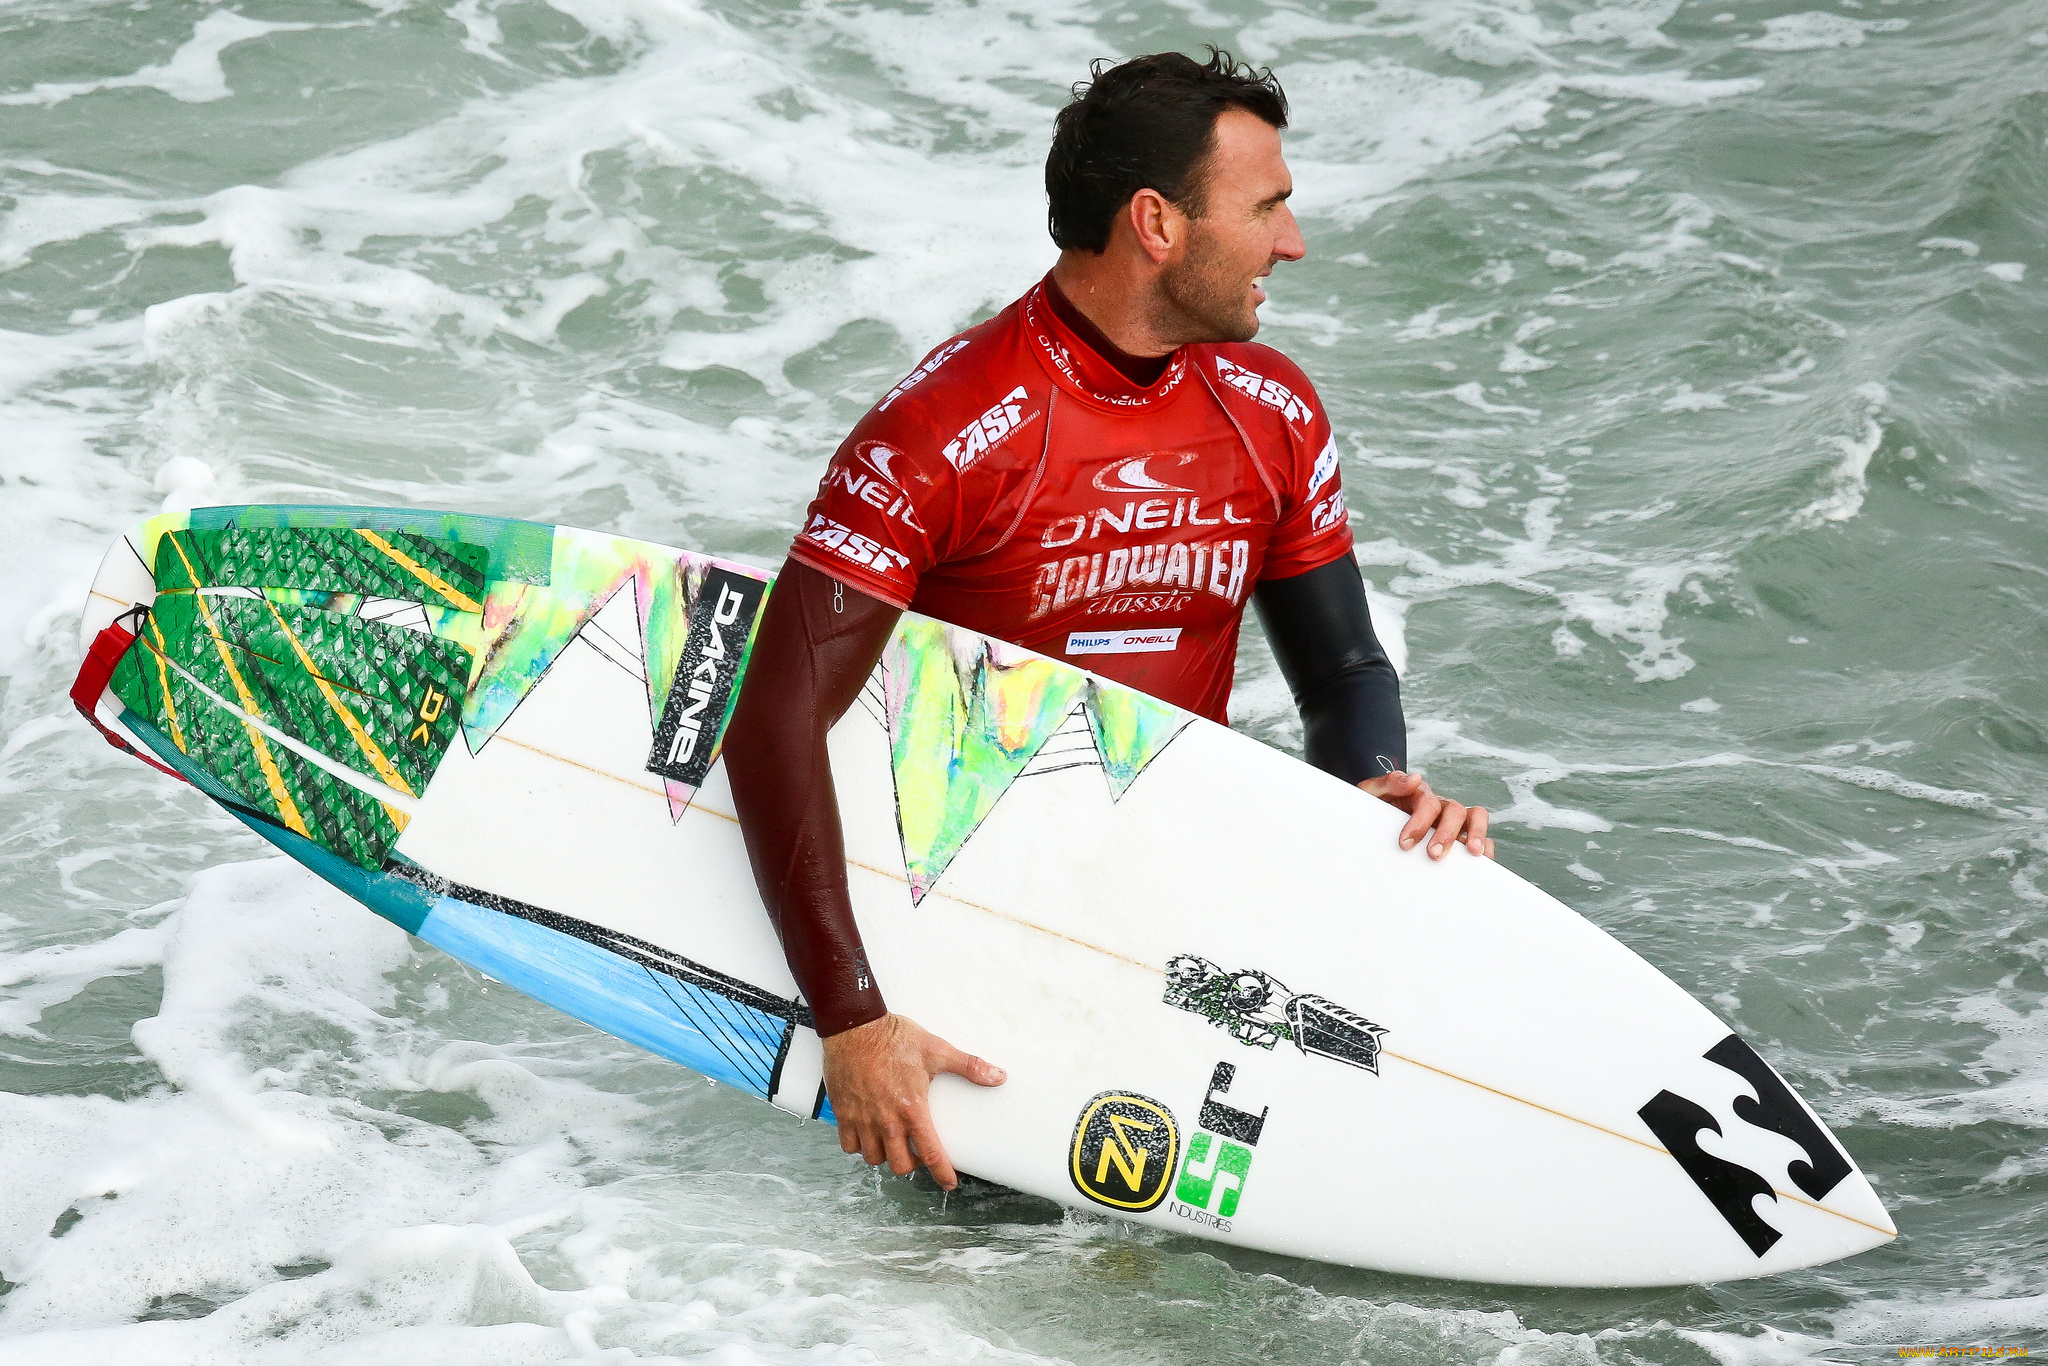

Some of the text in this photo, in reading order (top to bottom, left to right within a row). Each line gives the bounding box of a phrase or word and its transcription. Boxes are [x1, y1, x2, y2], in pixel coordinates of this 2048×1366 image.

[1027, 539, 1249, 622] COLDWATER
[1084, 589, 1191, 615] classic
[1070, 637, 1111, 647] PHILIPS
[665, 581, 744, 767] DAKINE
[1169, 1201, 1232, 1233] INDUSTRIES
